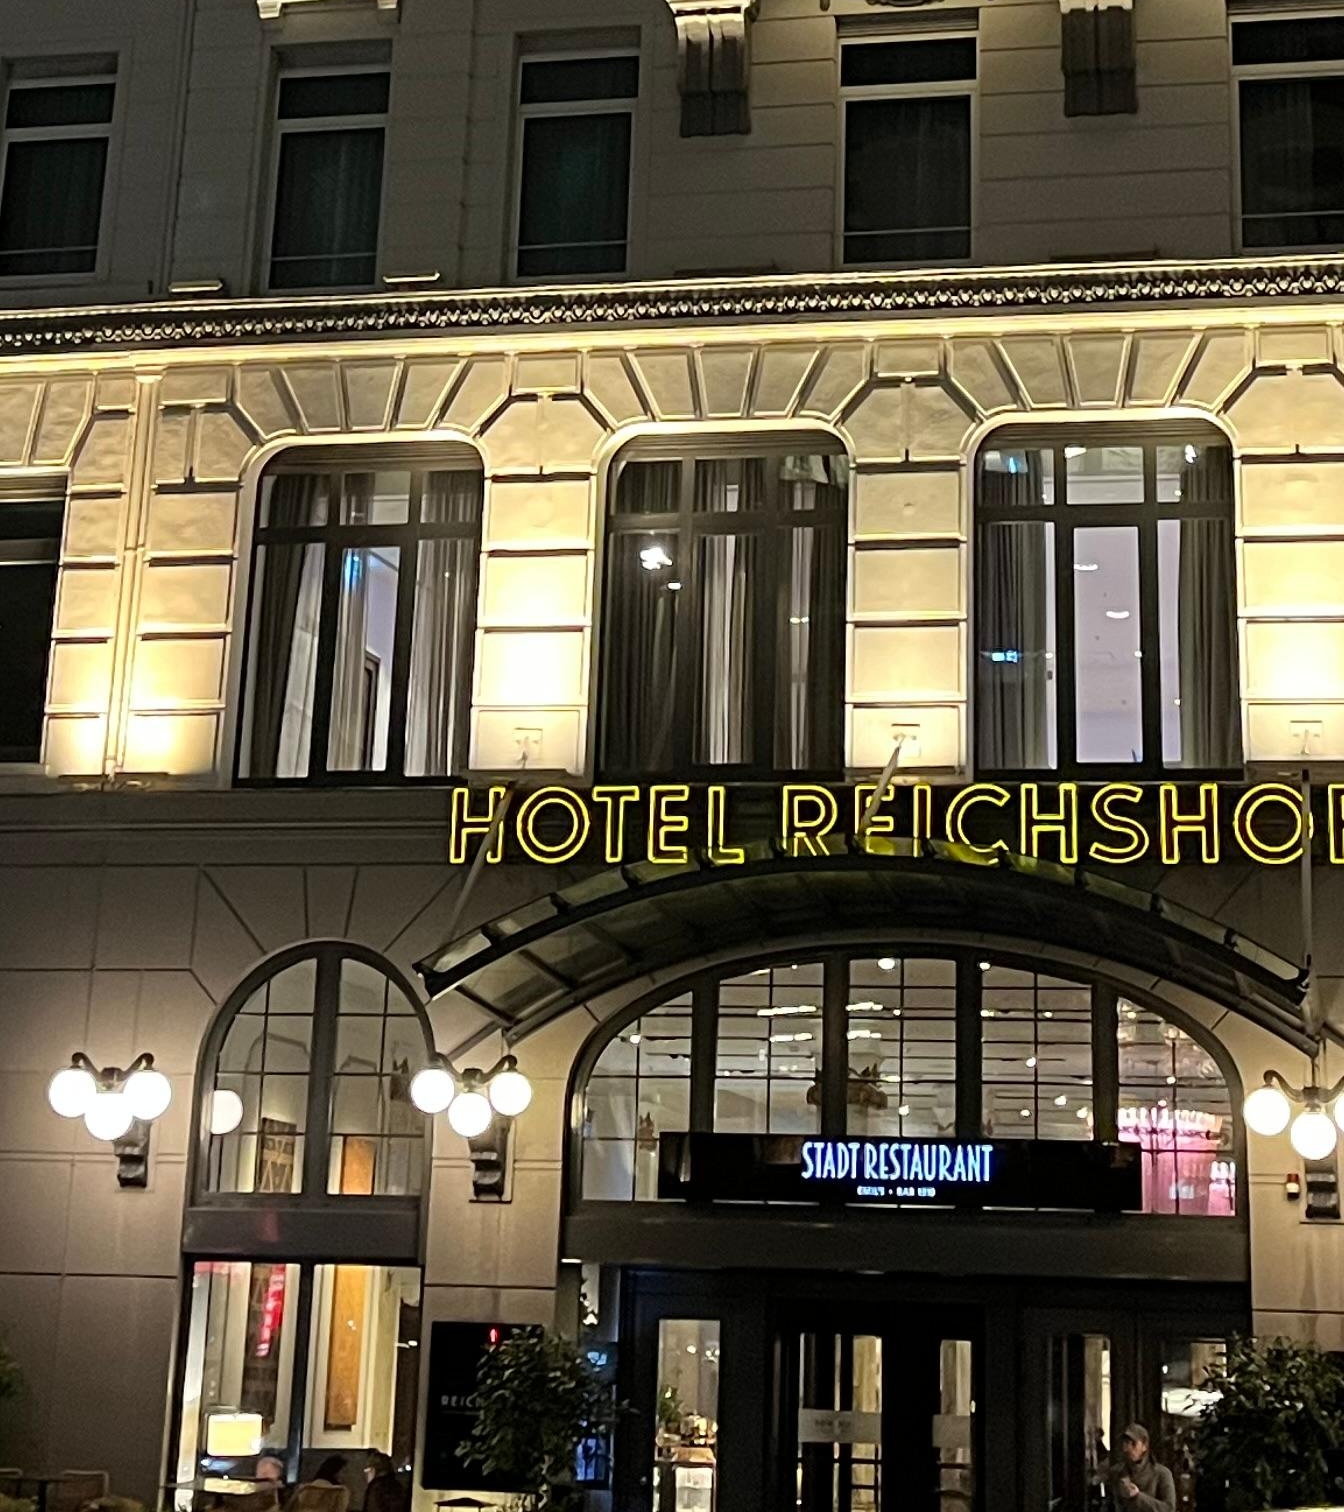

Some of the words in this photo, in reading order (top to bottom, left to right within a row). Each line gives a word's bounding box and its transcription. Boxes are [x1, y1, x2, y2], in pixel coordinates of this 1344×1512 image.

[449, 785, 745, 864] HOTEL
[801, 1141, 860, 1179] STADT
[863, 1142, 994, 1182] RESTAURANT
